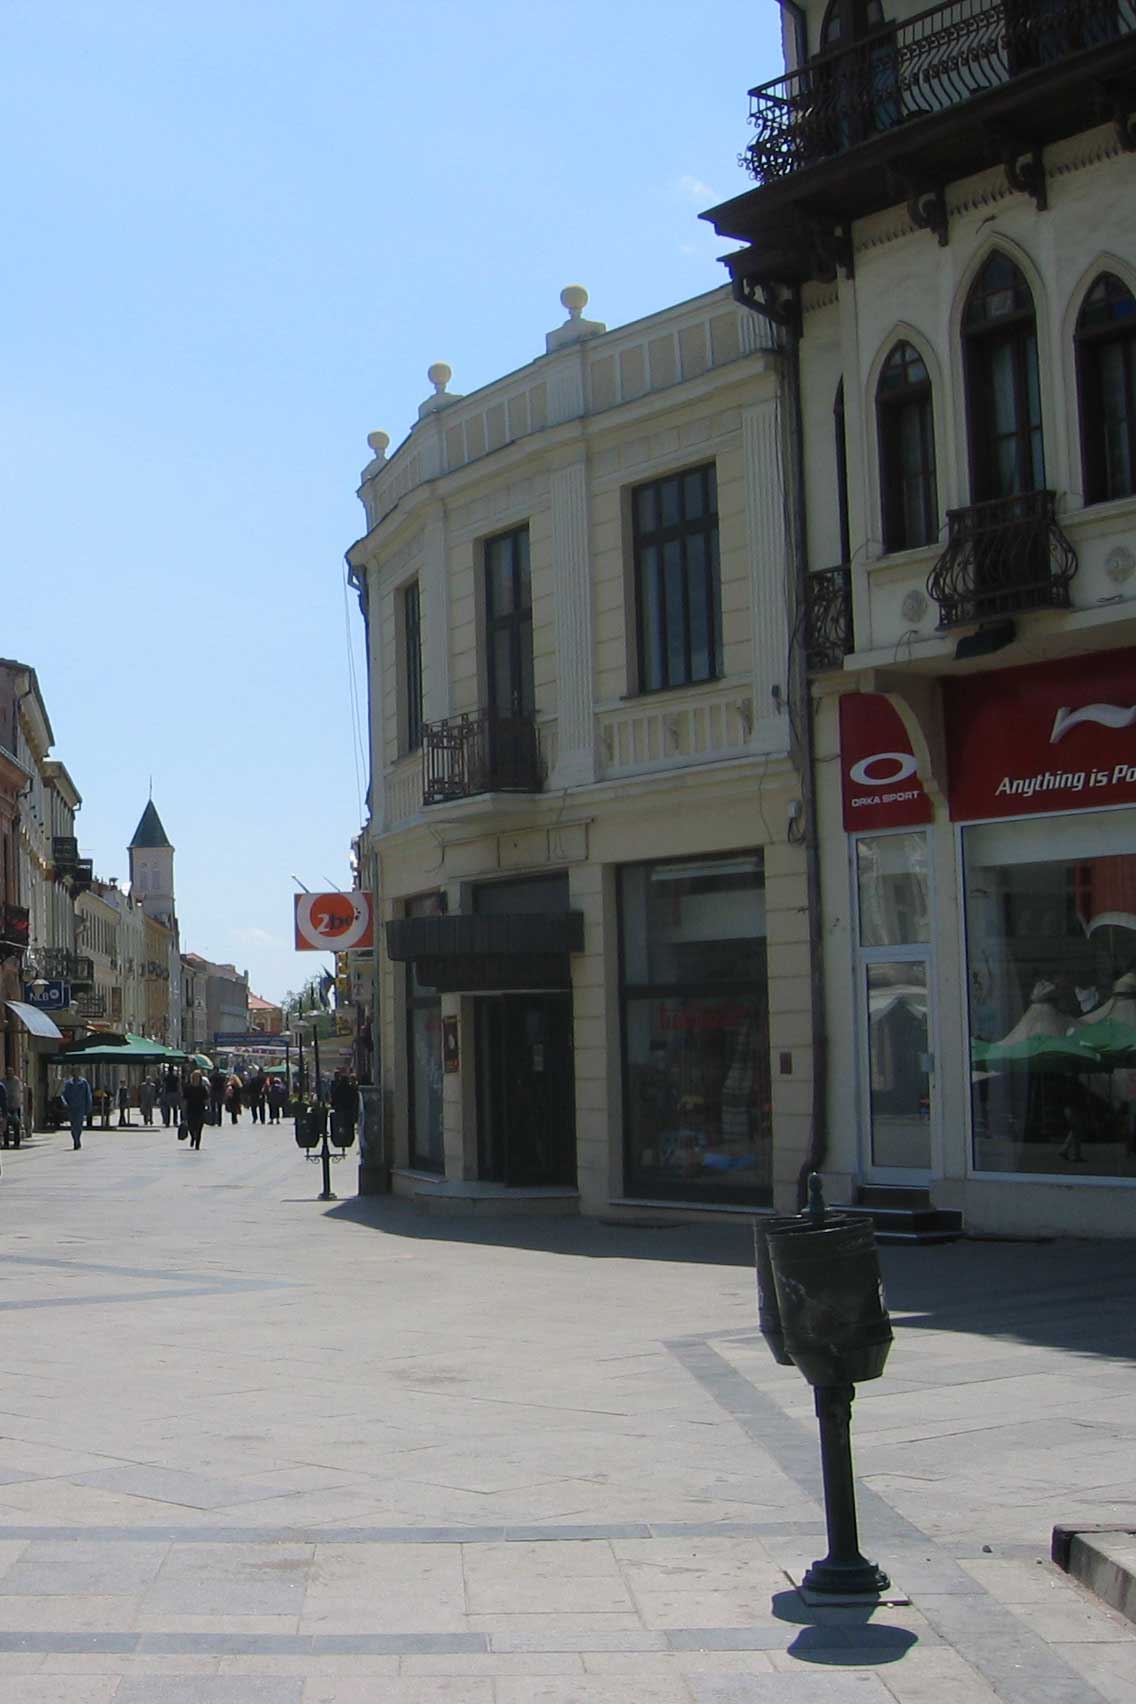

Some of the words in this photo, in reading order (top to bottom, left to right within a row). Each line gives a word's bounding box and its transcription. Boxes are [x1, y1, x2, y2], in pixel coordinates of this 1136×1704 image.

[994, 770, 1086, 797] Anything
[1089, 768, 1109, 787] is
[882, 790, 921, 803] SPORT
